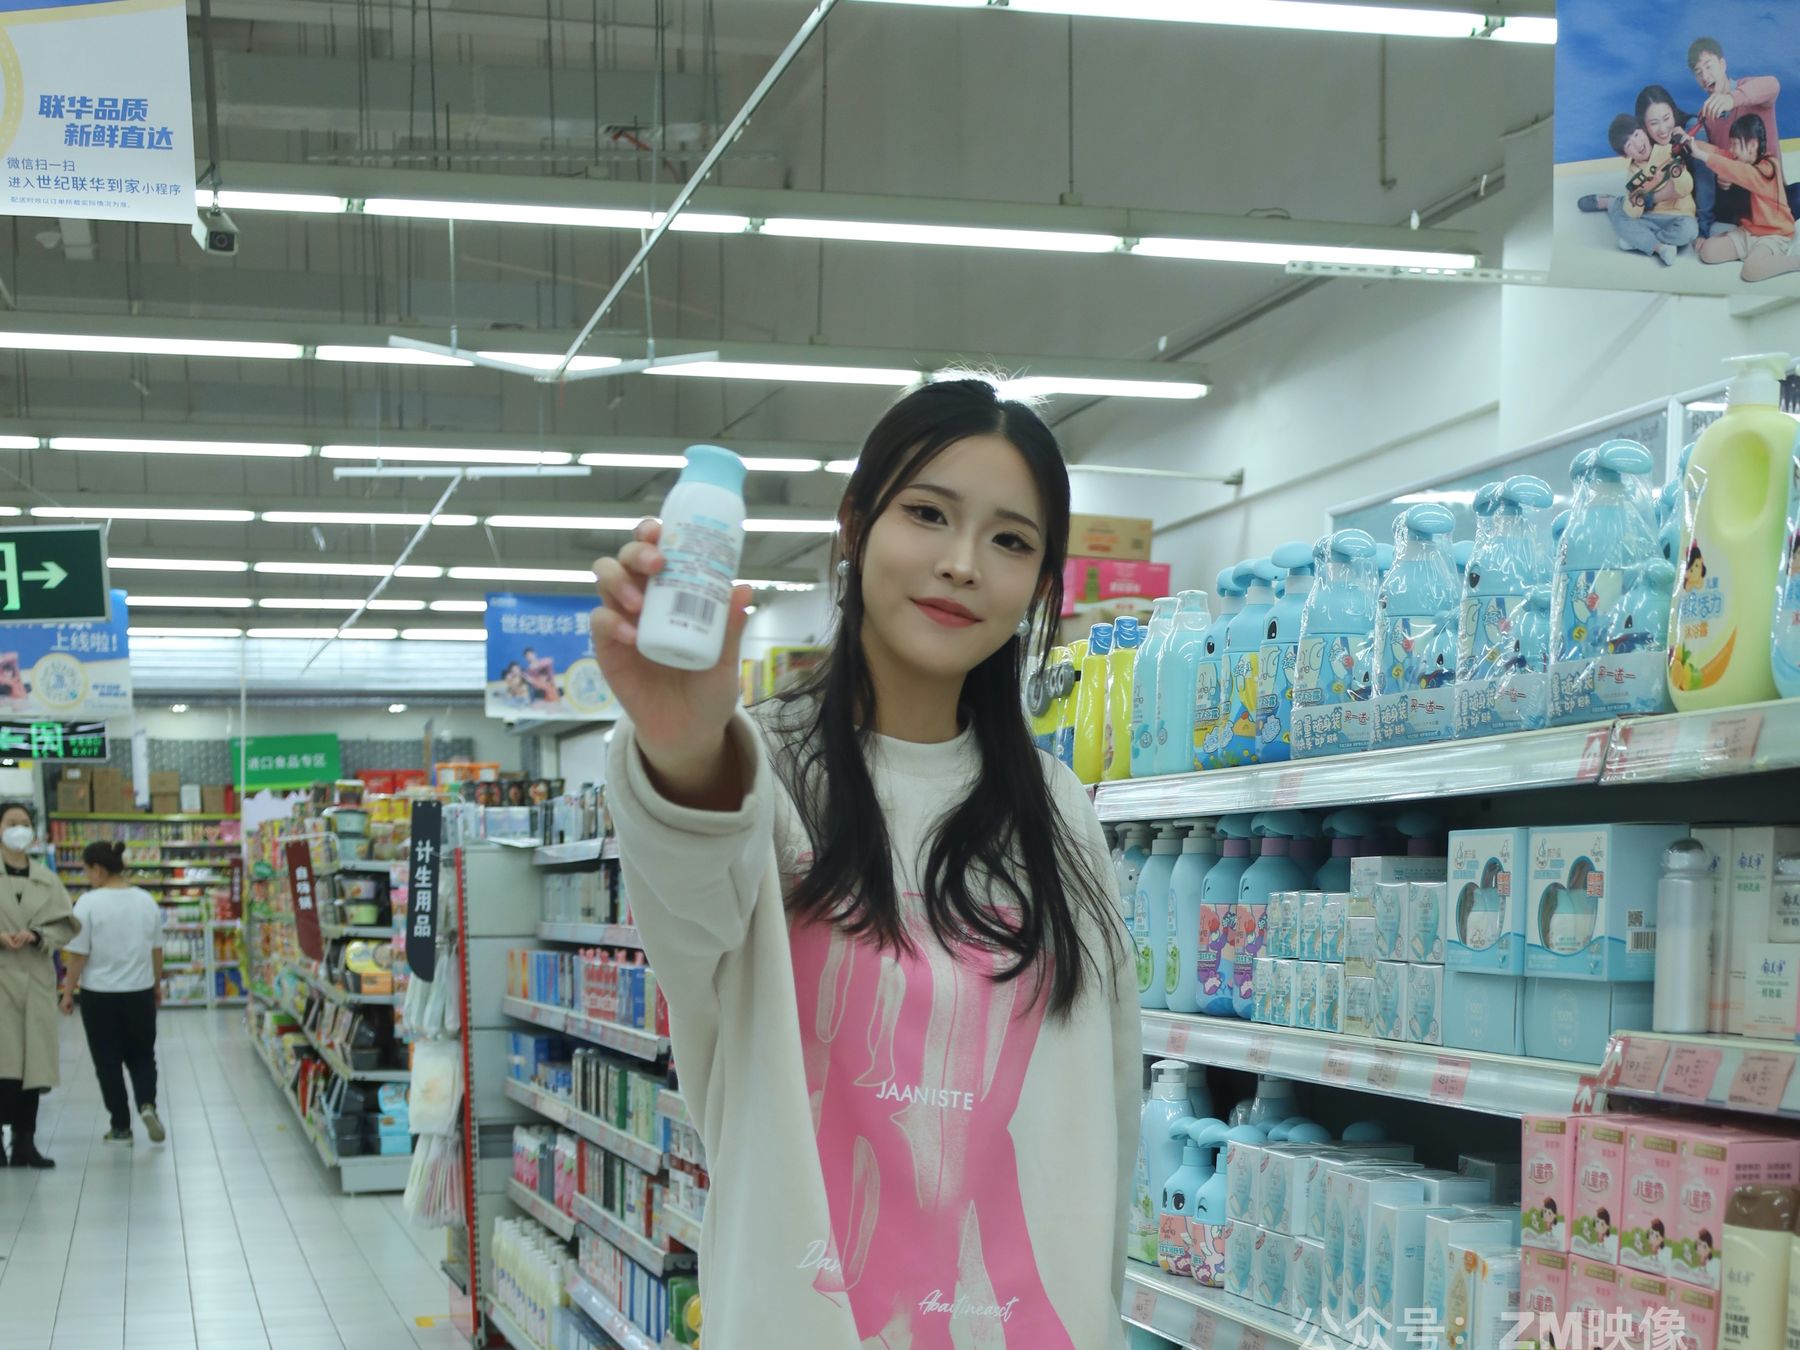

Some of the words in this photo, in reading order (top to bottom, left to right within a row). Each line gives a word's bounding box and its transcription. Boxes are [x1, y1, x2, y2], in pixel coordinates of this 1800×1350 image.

[38, 94, 149, 122] 联华品质
[64, 123, 174, 151] 新鲜直达
[7, 157, 76, 172] 微信扫一扫
[8, 174, 182, 196] 进入世纪联华到家小程序
[414, 839, 433, 938] 计生用品
[876, 1082, 974, 1111] JAANISTE
